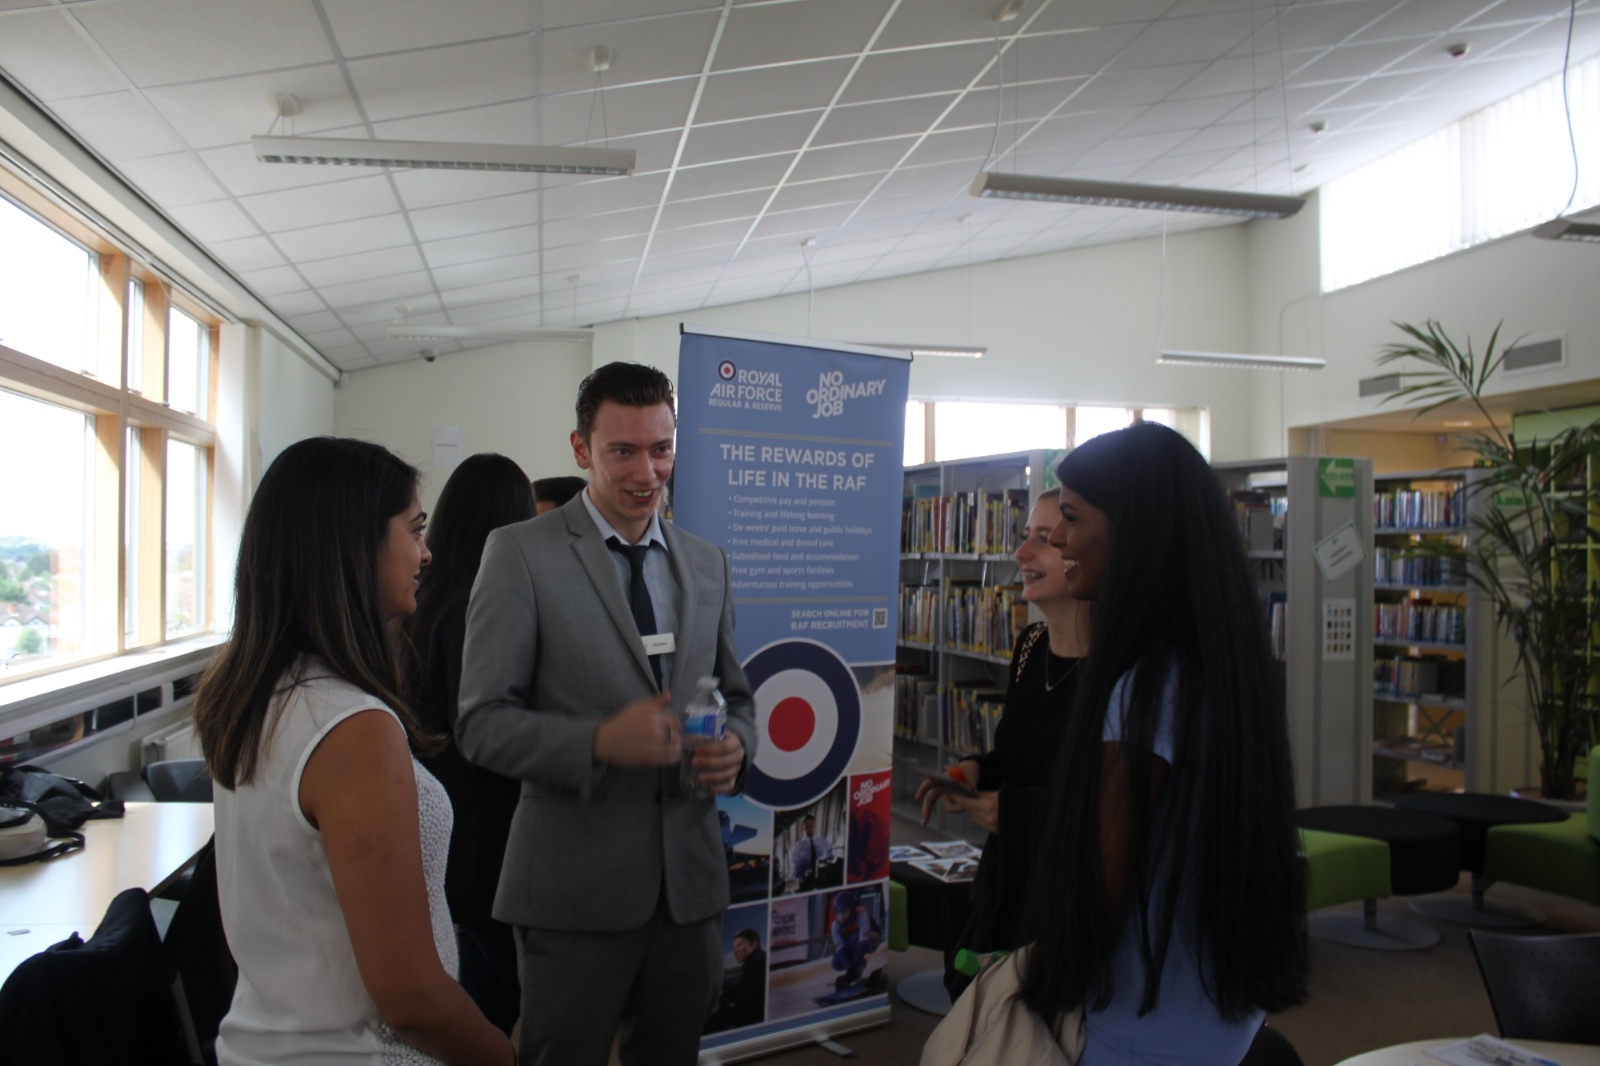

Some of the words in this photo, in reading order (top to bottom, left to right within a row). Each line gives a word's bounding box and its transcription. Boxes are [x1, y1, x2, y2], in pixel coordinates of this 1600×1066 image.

[738, 369, 783, 387] ROYAL
[819, 371, 844, 388] NO
[709, 383, 735, 398] AIR
[737, 385, 783, 403] FORCE
[806, 379, 887, 405] ORDINARY
[708, 398, 742, 408] REGULAR
[744, 400, 750, 409] &
[752, 402, 782, 412] RESERVE
[812, 401, 844, 420] JOB
[720, 444, 756, 462] THE
[761, 446, 847, 467] REWARDS
[851, 452, 875, 469] OF
[728, 469, 766, 487] LIFE
[772, 472, 790, 488] IN
[795, 472, 828, 490] THE
[833, 474, 867, 491] RAF
[733, 494, 777, 505] Competitive
[779, 497, 792, 506] pay
[794, 496, 807, 505] and
[808, 498, 836, 507] pension
[733, 509, 762, 520] Training
[764, 510, 778, 518] and
[780, 510, 805, 521] lifelong
[807, 511, 835, 522] learning
[732, 523, 744, 532] Six
[772, 524, 787, 534] paid
[789, 525, 807, 533] leave
[808, 525, 822, 534] and
[824, 526, 843, 535] public
[845, 526, 872, 536] holidays
[732, 538, 748, 546] Free
[750, 538, 779, 547] medical
[780, 538, 794, 547] and
[795, 539, 818, 547] dental
[732, 552, 771, 561] Subsidised
[772, 552, 789, 560] food
[790, 552, 804, 561] and
[806, 552, 859, 561] accommodation
[732, 566, 748, 575] Free
[749, 568, 766, 576] gym
[767, 566, 781, 574] and
[782, 566, 805, 576] sports
[806, 566, 834, 575] facilities
[732, 580, 778, 589] Adventurous
[779, 580, 806, 590] training
[808, 580, 853, 590] opportunities
[791, 610, 822, 619] SEARCH
[824, 609, 852, 618] ONLINE
[854, 609, 870, 617] FOR
[791, 622, 809, 631] RAF
[811, 620, 869, 630] RECRUITMENT
[853, 777, 891, 800] ORDINARY
[860, 779, 873, 791] NO
[856, 794, 873, 807] JOB
